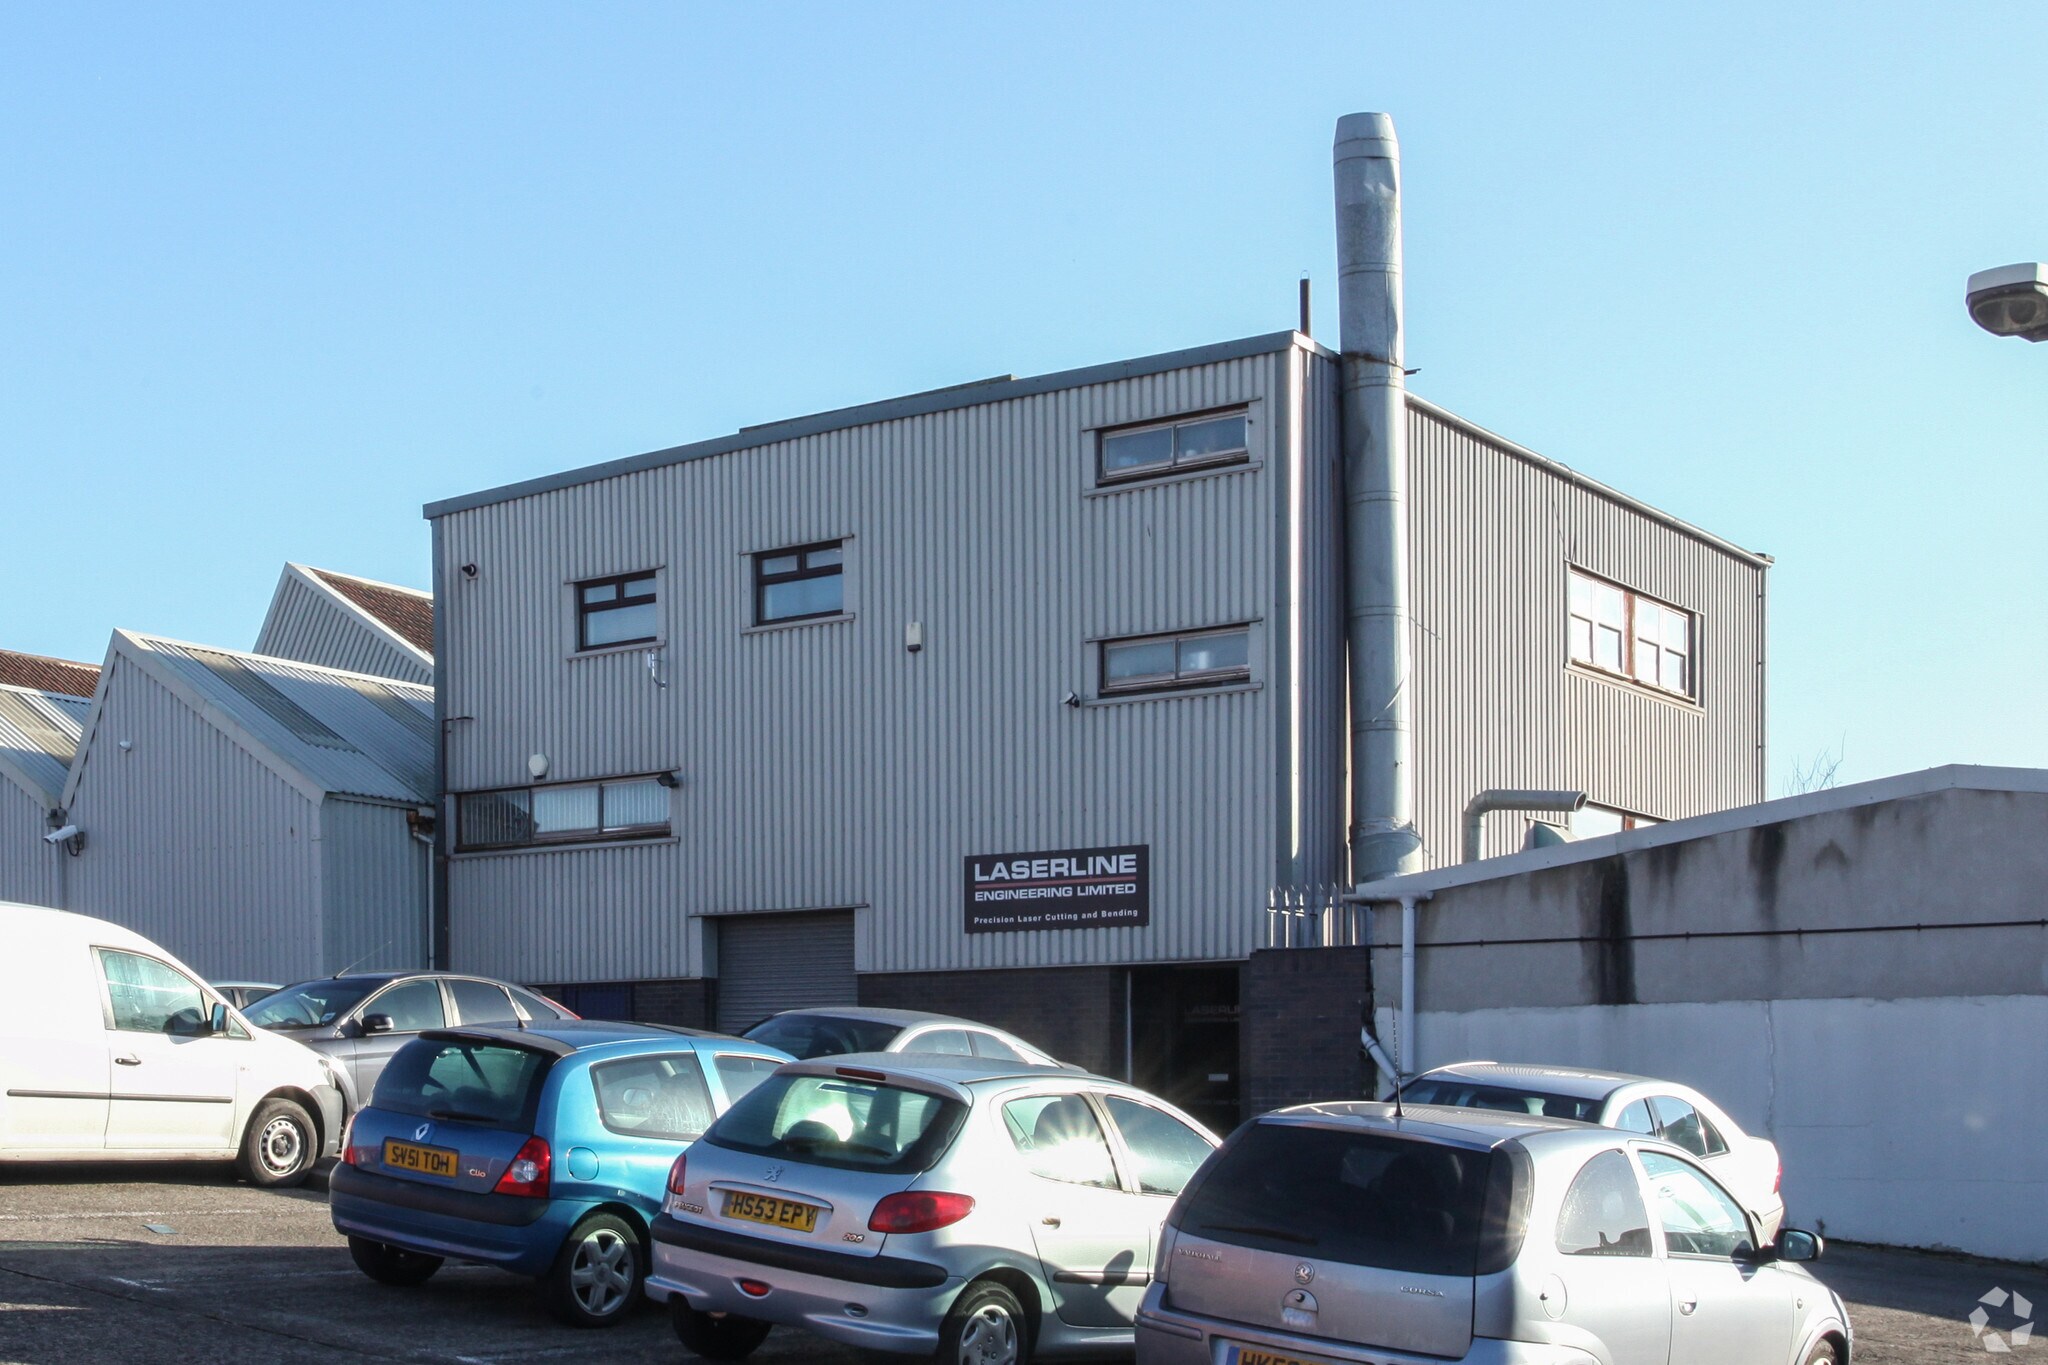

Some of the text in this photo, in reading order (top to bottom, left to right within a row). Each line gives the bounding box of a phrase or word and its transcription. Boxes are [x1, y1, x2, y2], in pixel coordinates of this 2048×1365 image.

[974, 853, 1137, 882] LASERLINE
[975, 883, 1136, 902] ENGINEERING LIMITED
[974, 909, 1138, 924] Precision Laser Cutting and Bending
[423, 1151, 450, 1172] TOH
[469, 1168, 486, 1178] Clio
[732, 1194, 816, 1228] HS53 EPY
[843, 1229, 864, 1243] 206
[1400, 1286, 1444, 1297] CORSA
